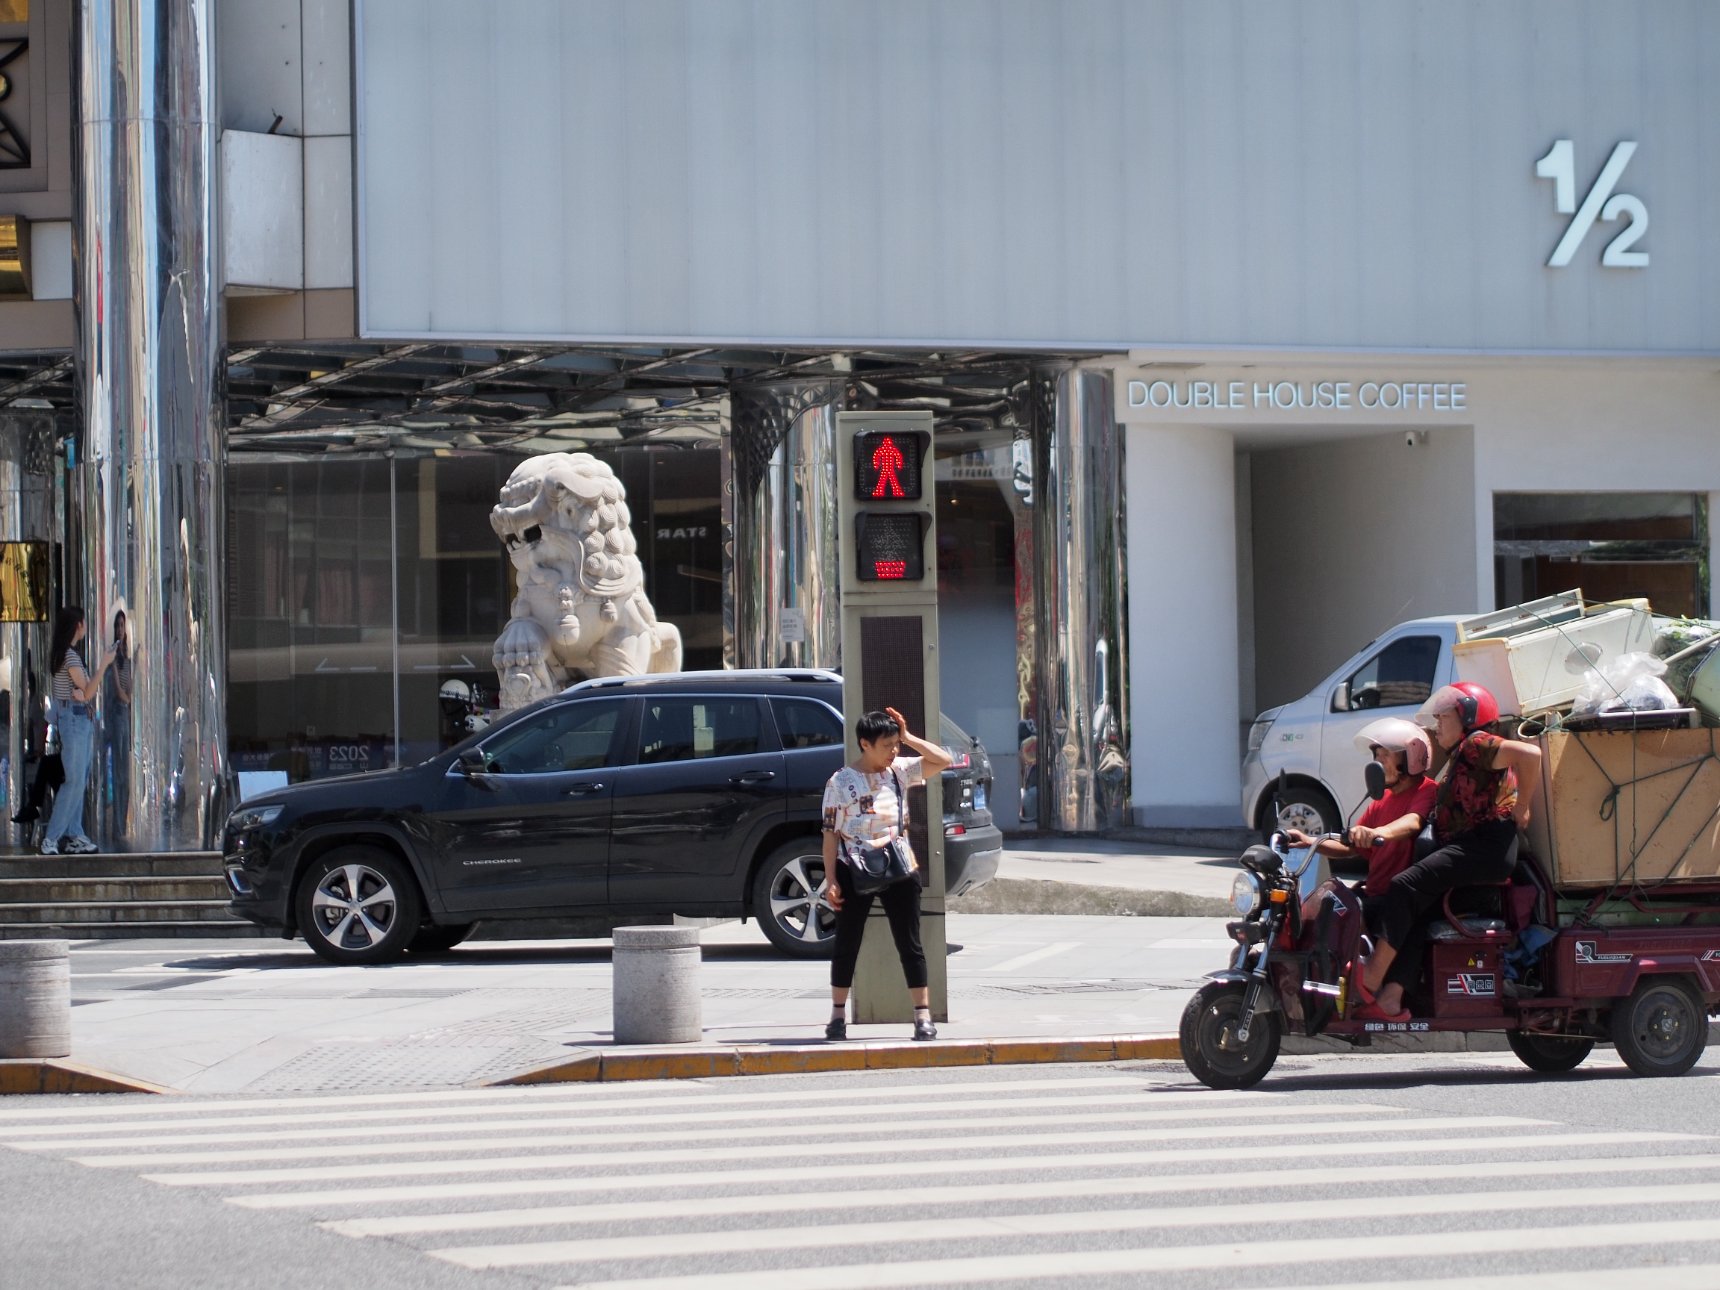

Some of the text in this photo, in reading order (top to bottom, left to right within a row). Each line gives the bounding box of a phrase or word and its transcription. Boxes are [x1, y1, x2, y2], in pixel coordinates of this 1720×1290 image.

[1127, 381, 1467, 411] DOUBLE HOUSE COFFEE
[462, 858, 522, 866] CHEROKEE
